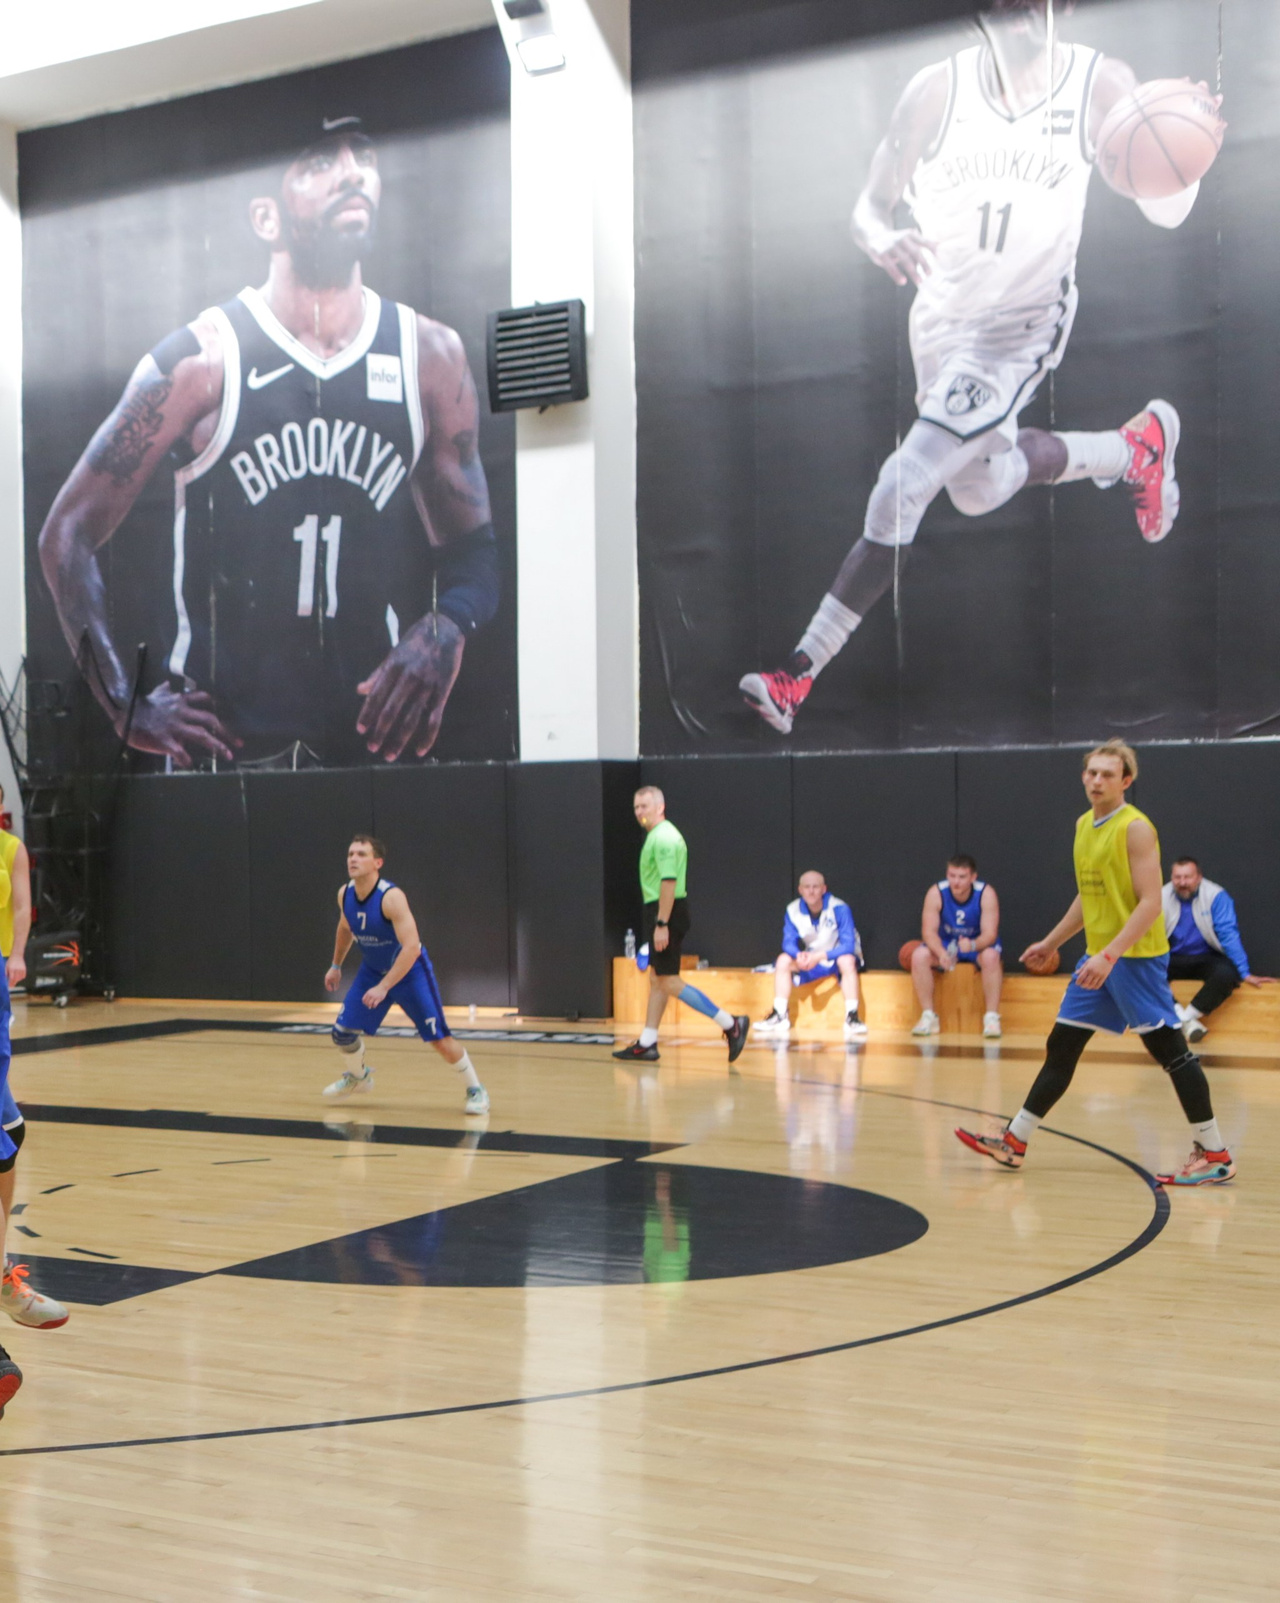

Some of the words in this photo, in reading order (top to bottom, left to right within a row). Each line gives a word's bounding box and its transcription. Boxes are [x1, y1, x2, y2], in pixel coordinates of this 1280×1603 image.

[941, 148, 1075, 190] BROOKLYN
[977, 201, 1013, 254] 11
[370, 367, 398, 385] infor
[230, 417, 407, 512] BROOKLYN
[293, 514, 342, 618] 11
[357, 911, 367, 930] 7
[956, 909, 966, 926] 2
[425, 1017, 437, 1036] 7
